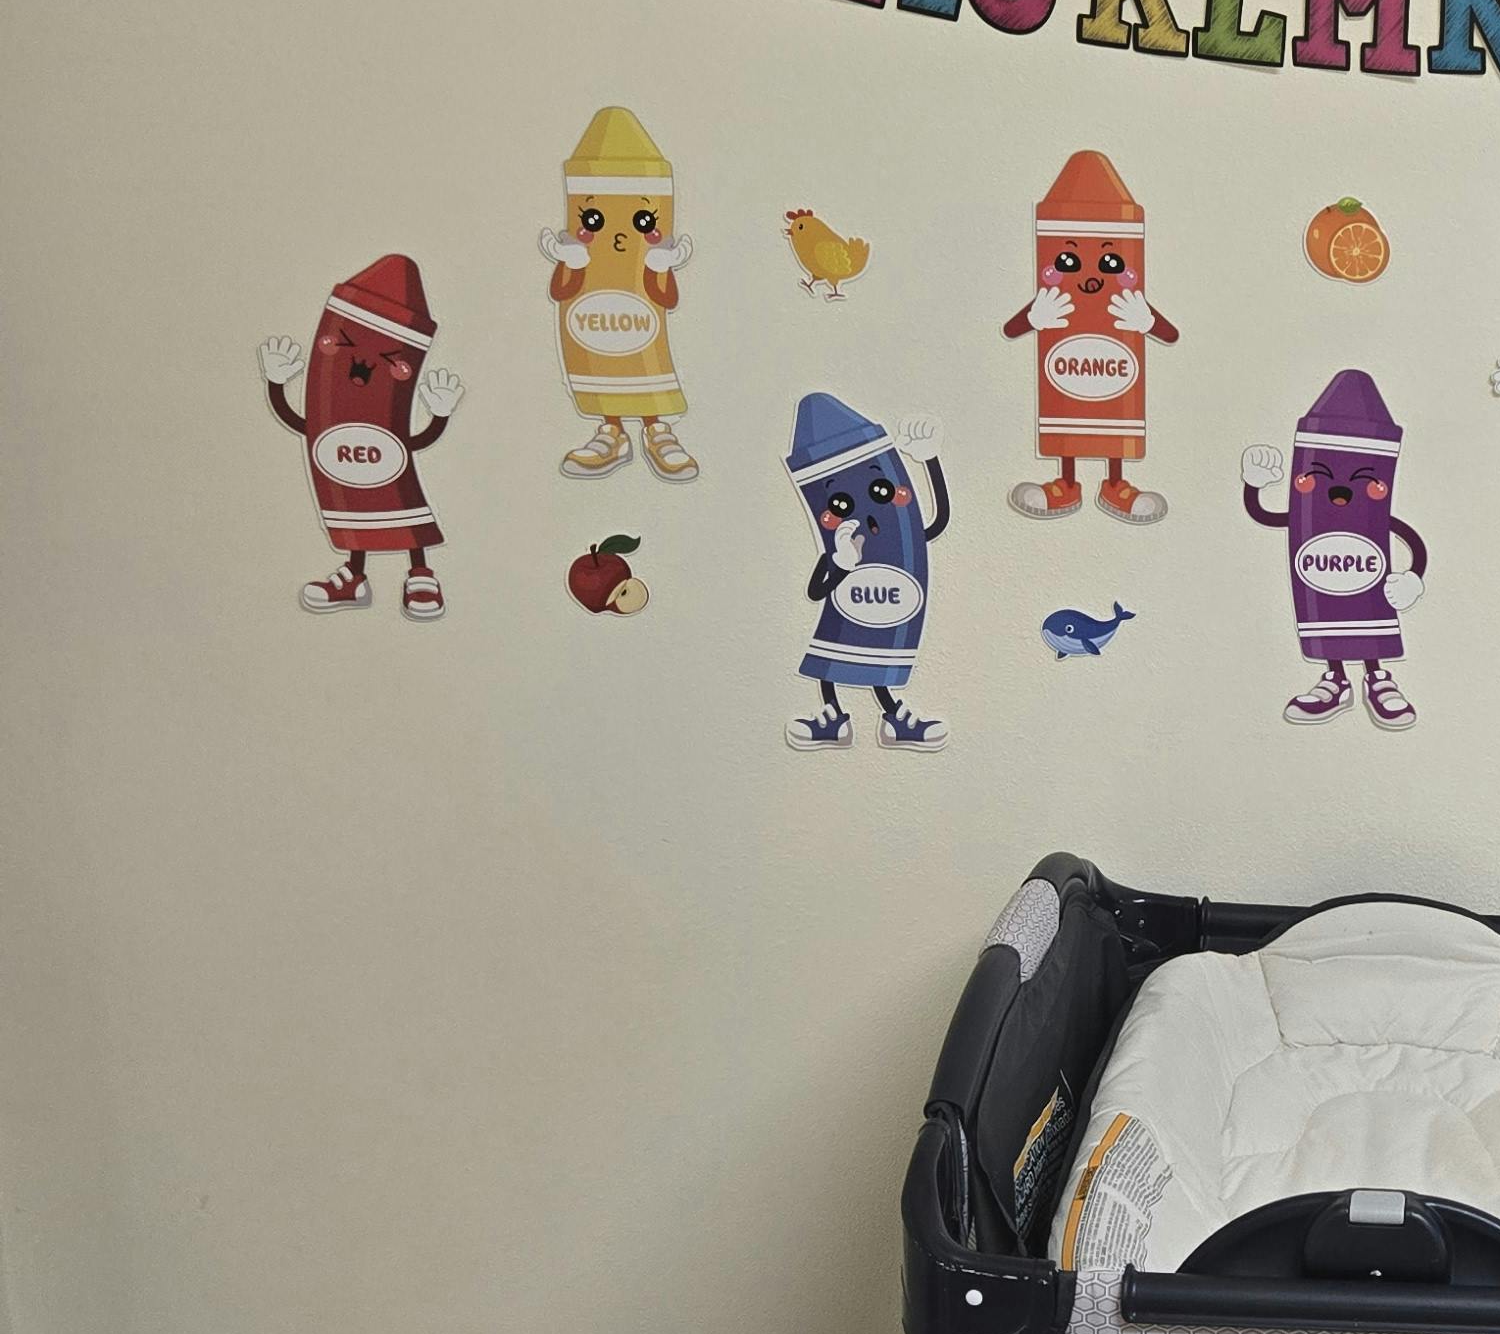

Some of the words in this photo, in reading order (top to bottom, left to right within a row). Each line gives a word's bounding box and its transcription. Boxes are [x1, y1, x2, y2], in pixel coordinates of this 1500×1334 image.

[574, 311, 652, 335] YELLOW
[1054, 356, 1129, 378] ORANGE
[336, 445, 382, 465] RED
[1301, 553, 1378, 575] PURPLE
[850, 585, 900, 606] BLUE
